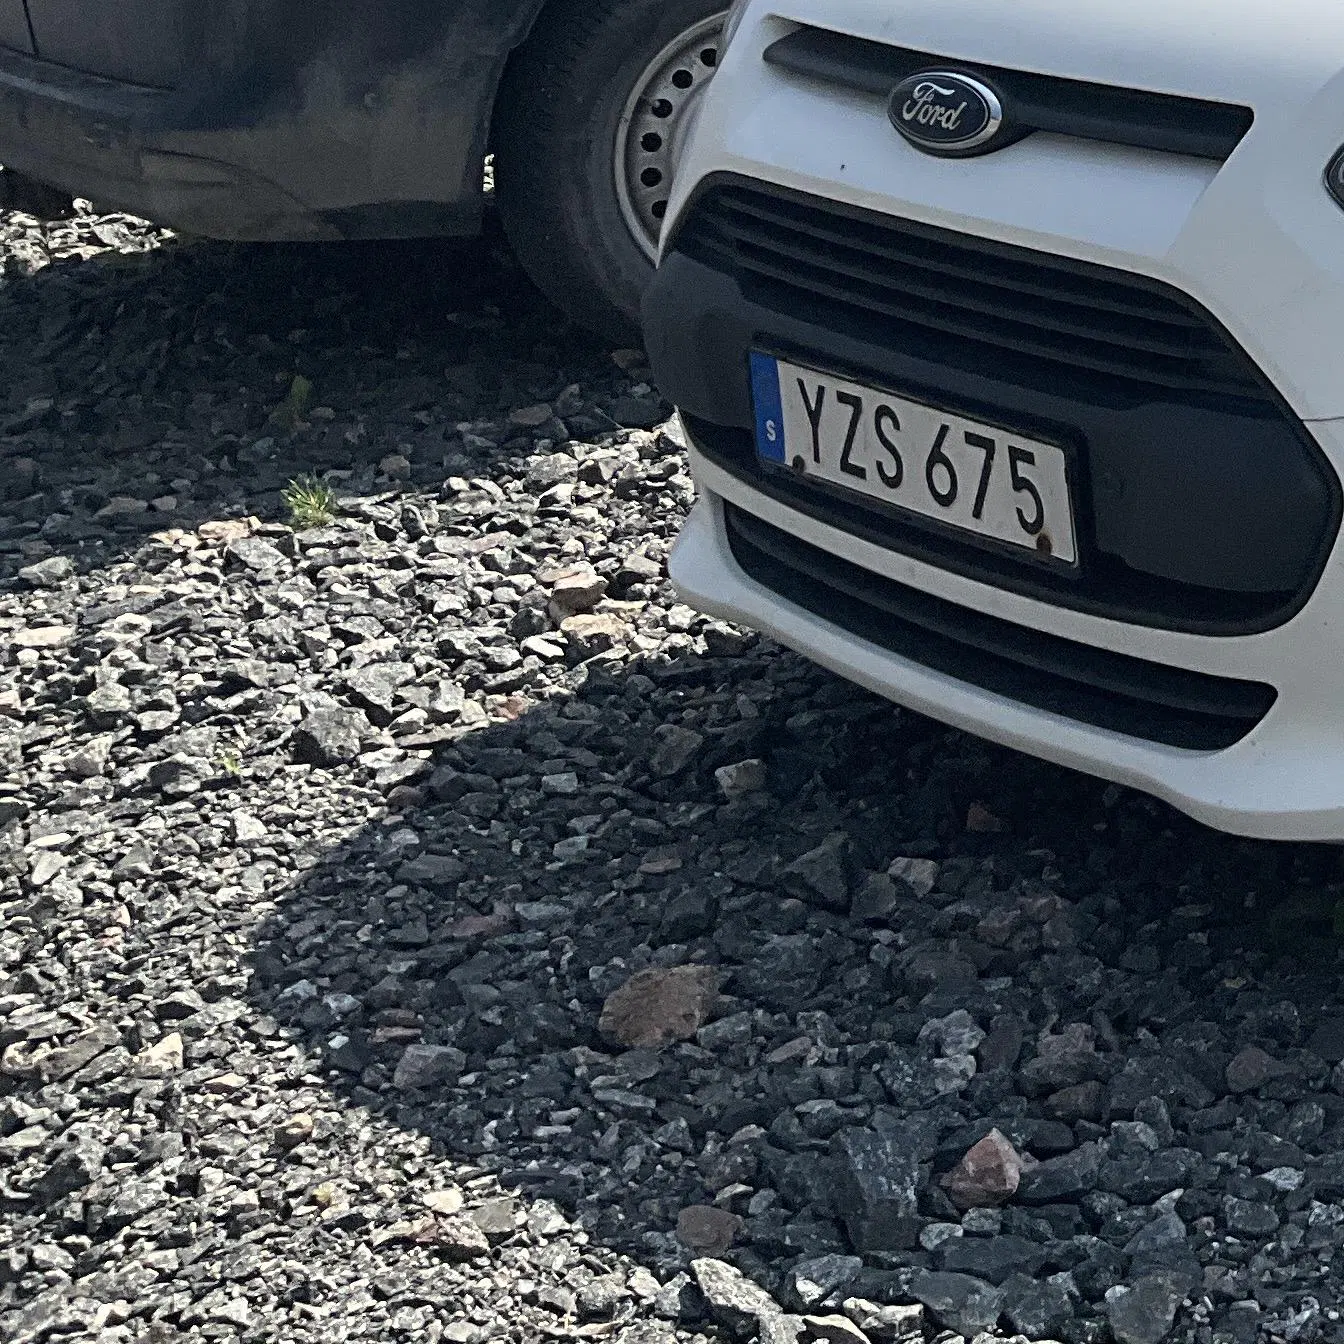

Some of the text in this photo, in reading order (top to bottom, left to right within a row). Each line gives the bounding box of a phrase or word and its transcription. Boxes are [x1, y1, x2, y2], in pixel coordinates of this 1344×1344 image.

[902, 82, 968, 131] Ford
[765, 419, 777, 442] S
[797, 378, 1045, 535] YZS 675
